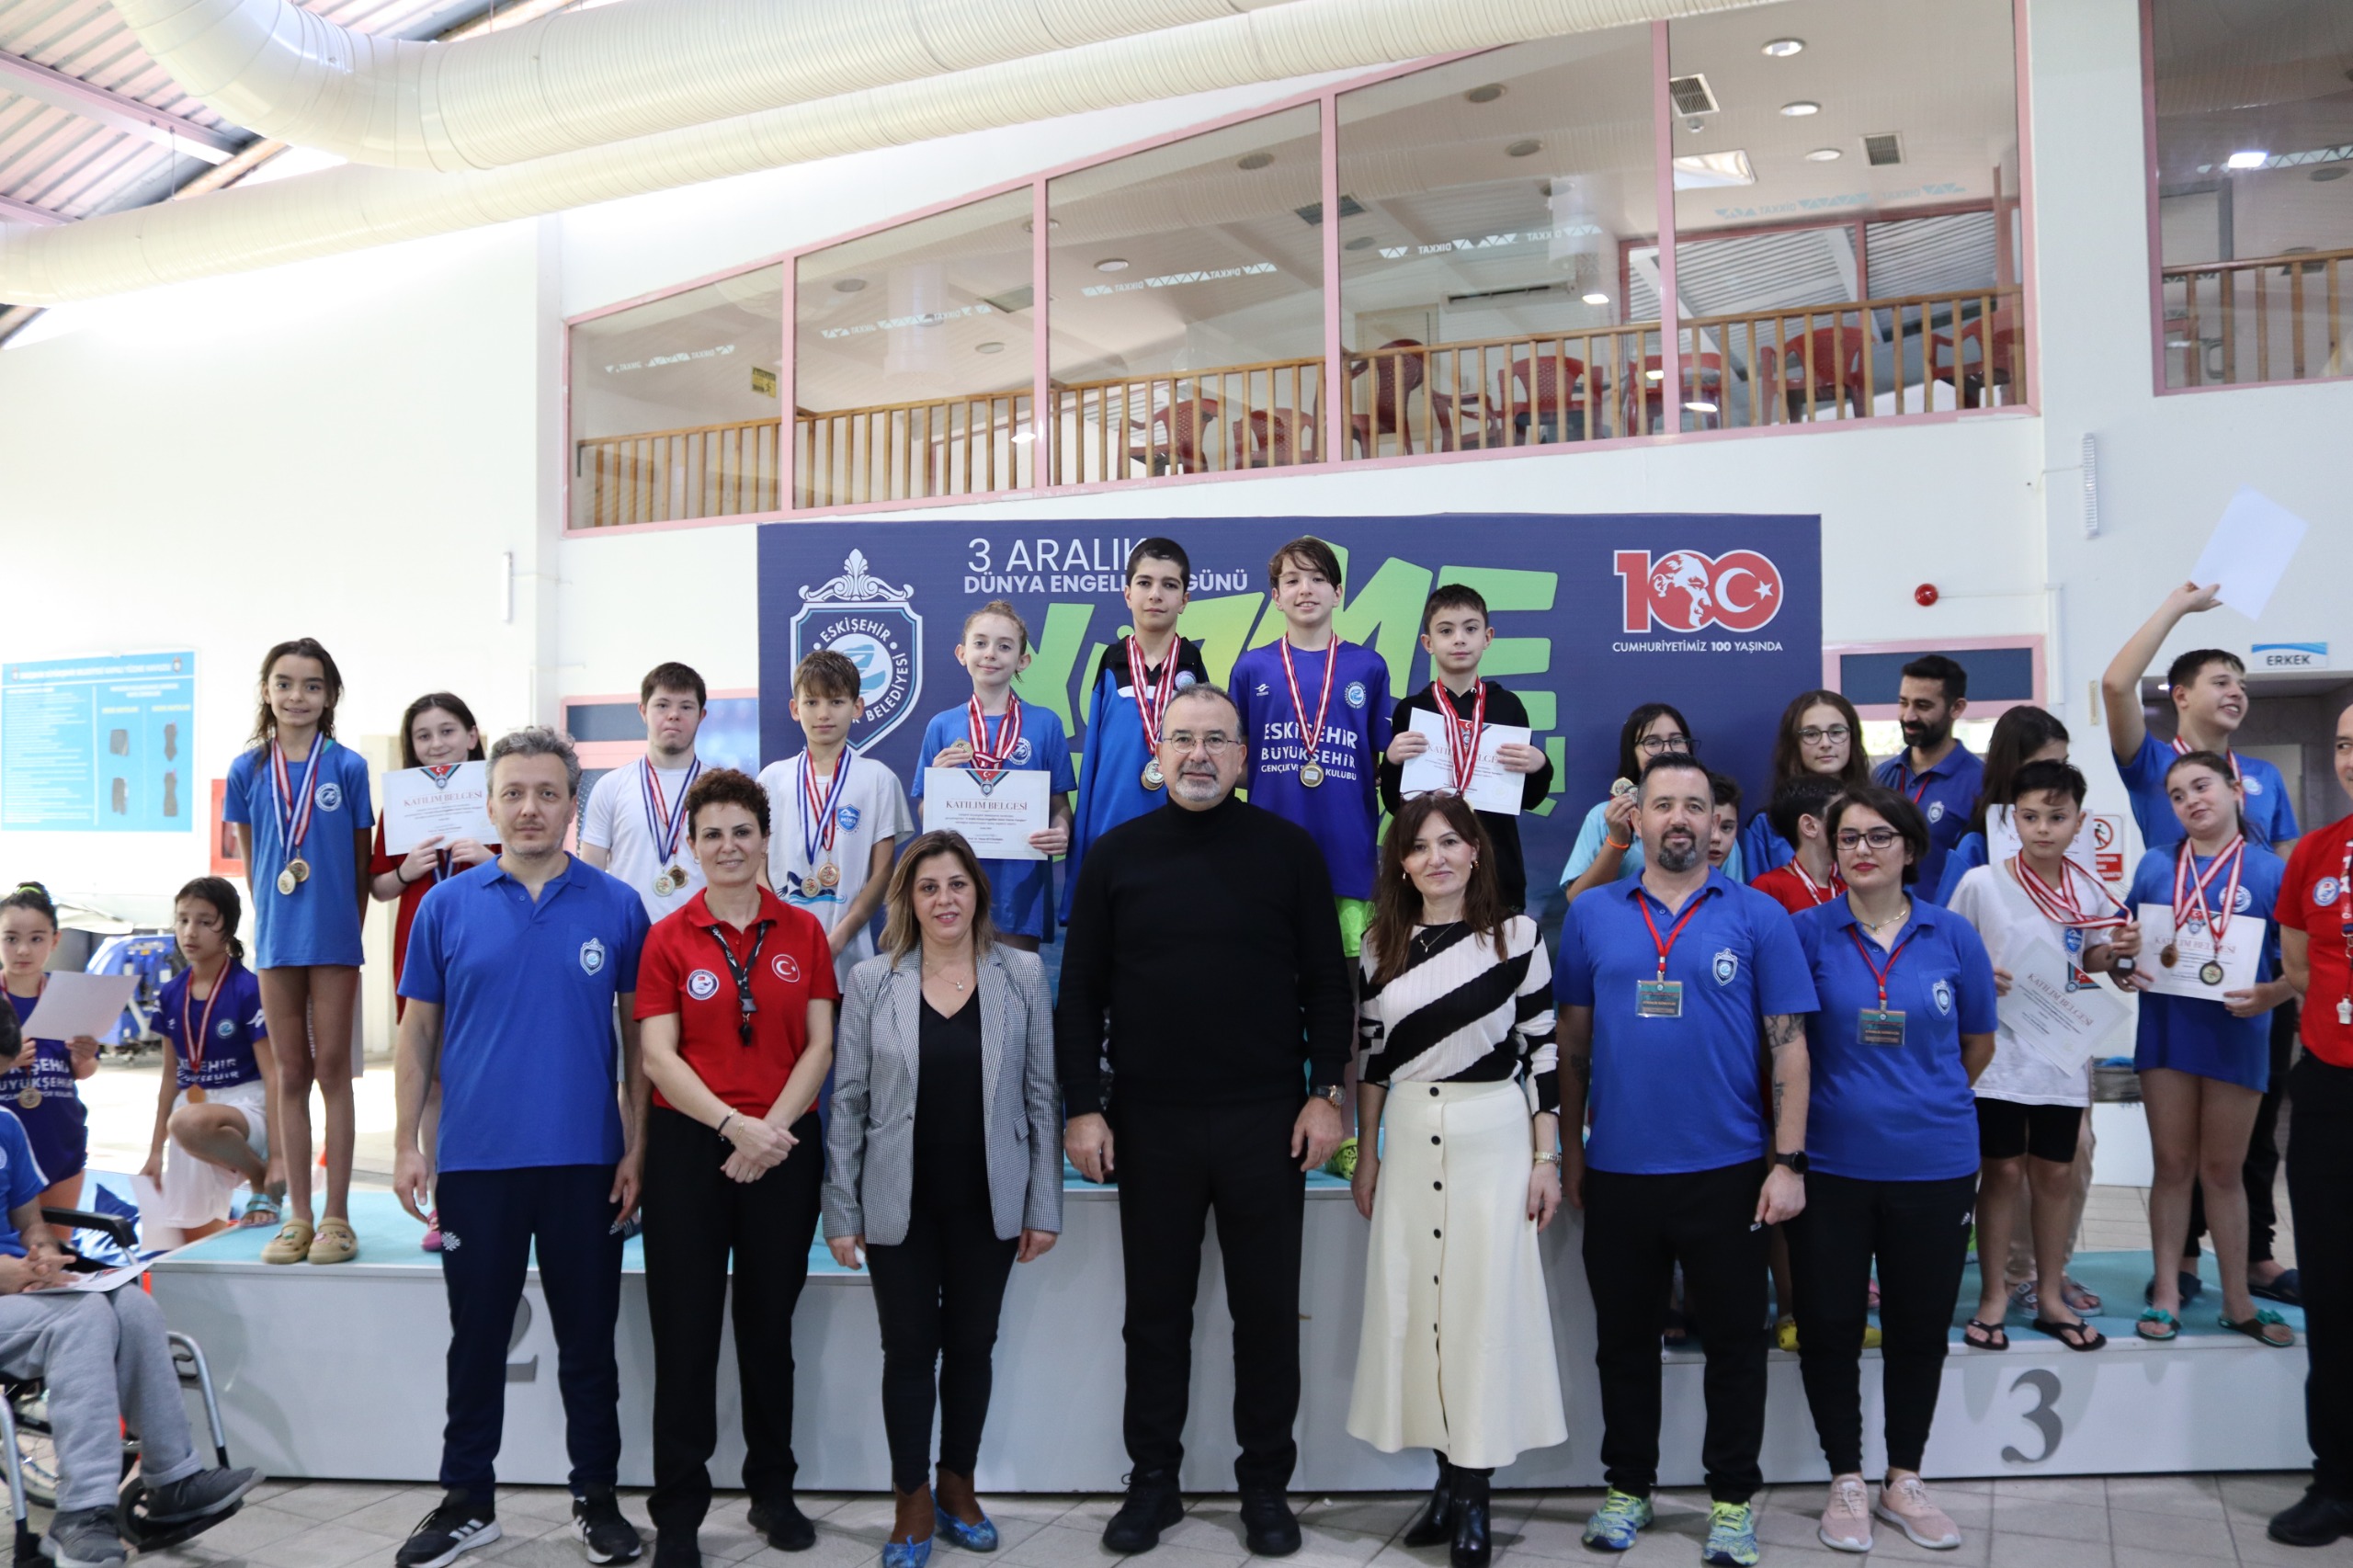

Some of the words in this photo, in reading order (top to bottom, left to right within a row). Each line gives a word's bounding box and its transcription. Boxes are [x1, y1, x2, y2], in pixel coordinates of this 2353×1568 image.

[968, 538, 991, 573] 3
[1006, 538, 1149, 572] ARALIK
[964, 571, 1045, 593] DÜNYA
[819, 617, 892, 642] ESKİŞEHİR
[1612, 640, 1707, 652] CUMHURİYETİMİZ
[1711, 642, 1732, 652] 100
[1735, 642, 1783, 653] YAŞINDA
[2266, 654, 2312, 665] ERKEK
[865, 652, 909, 722] BELEDİYESİ
[946, 801, 985, 809] KATILIM
[988, 801, 1027, 811] BELGESİ
[2027, 972, 2062, 1004] KATILIM
[2001, 1369, 2063, 1463] 3
